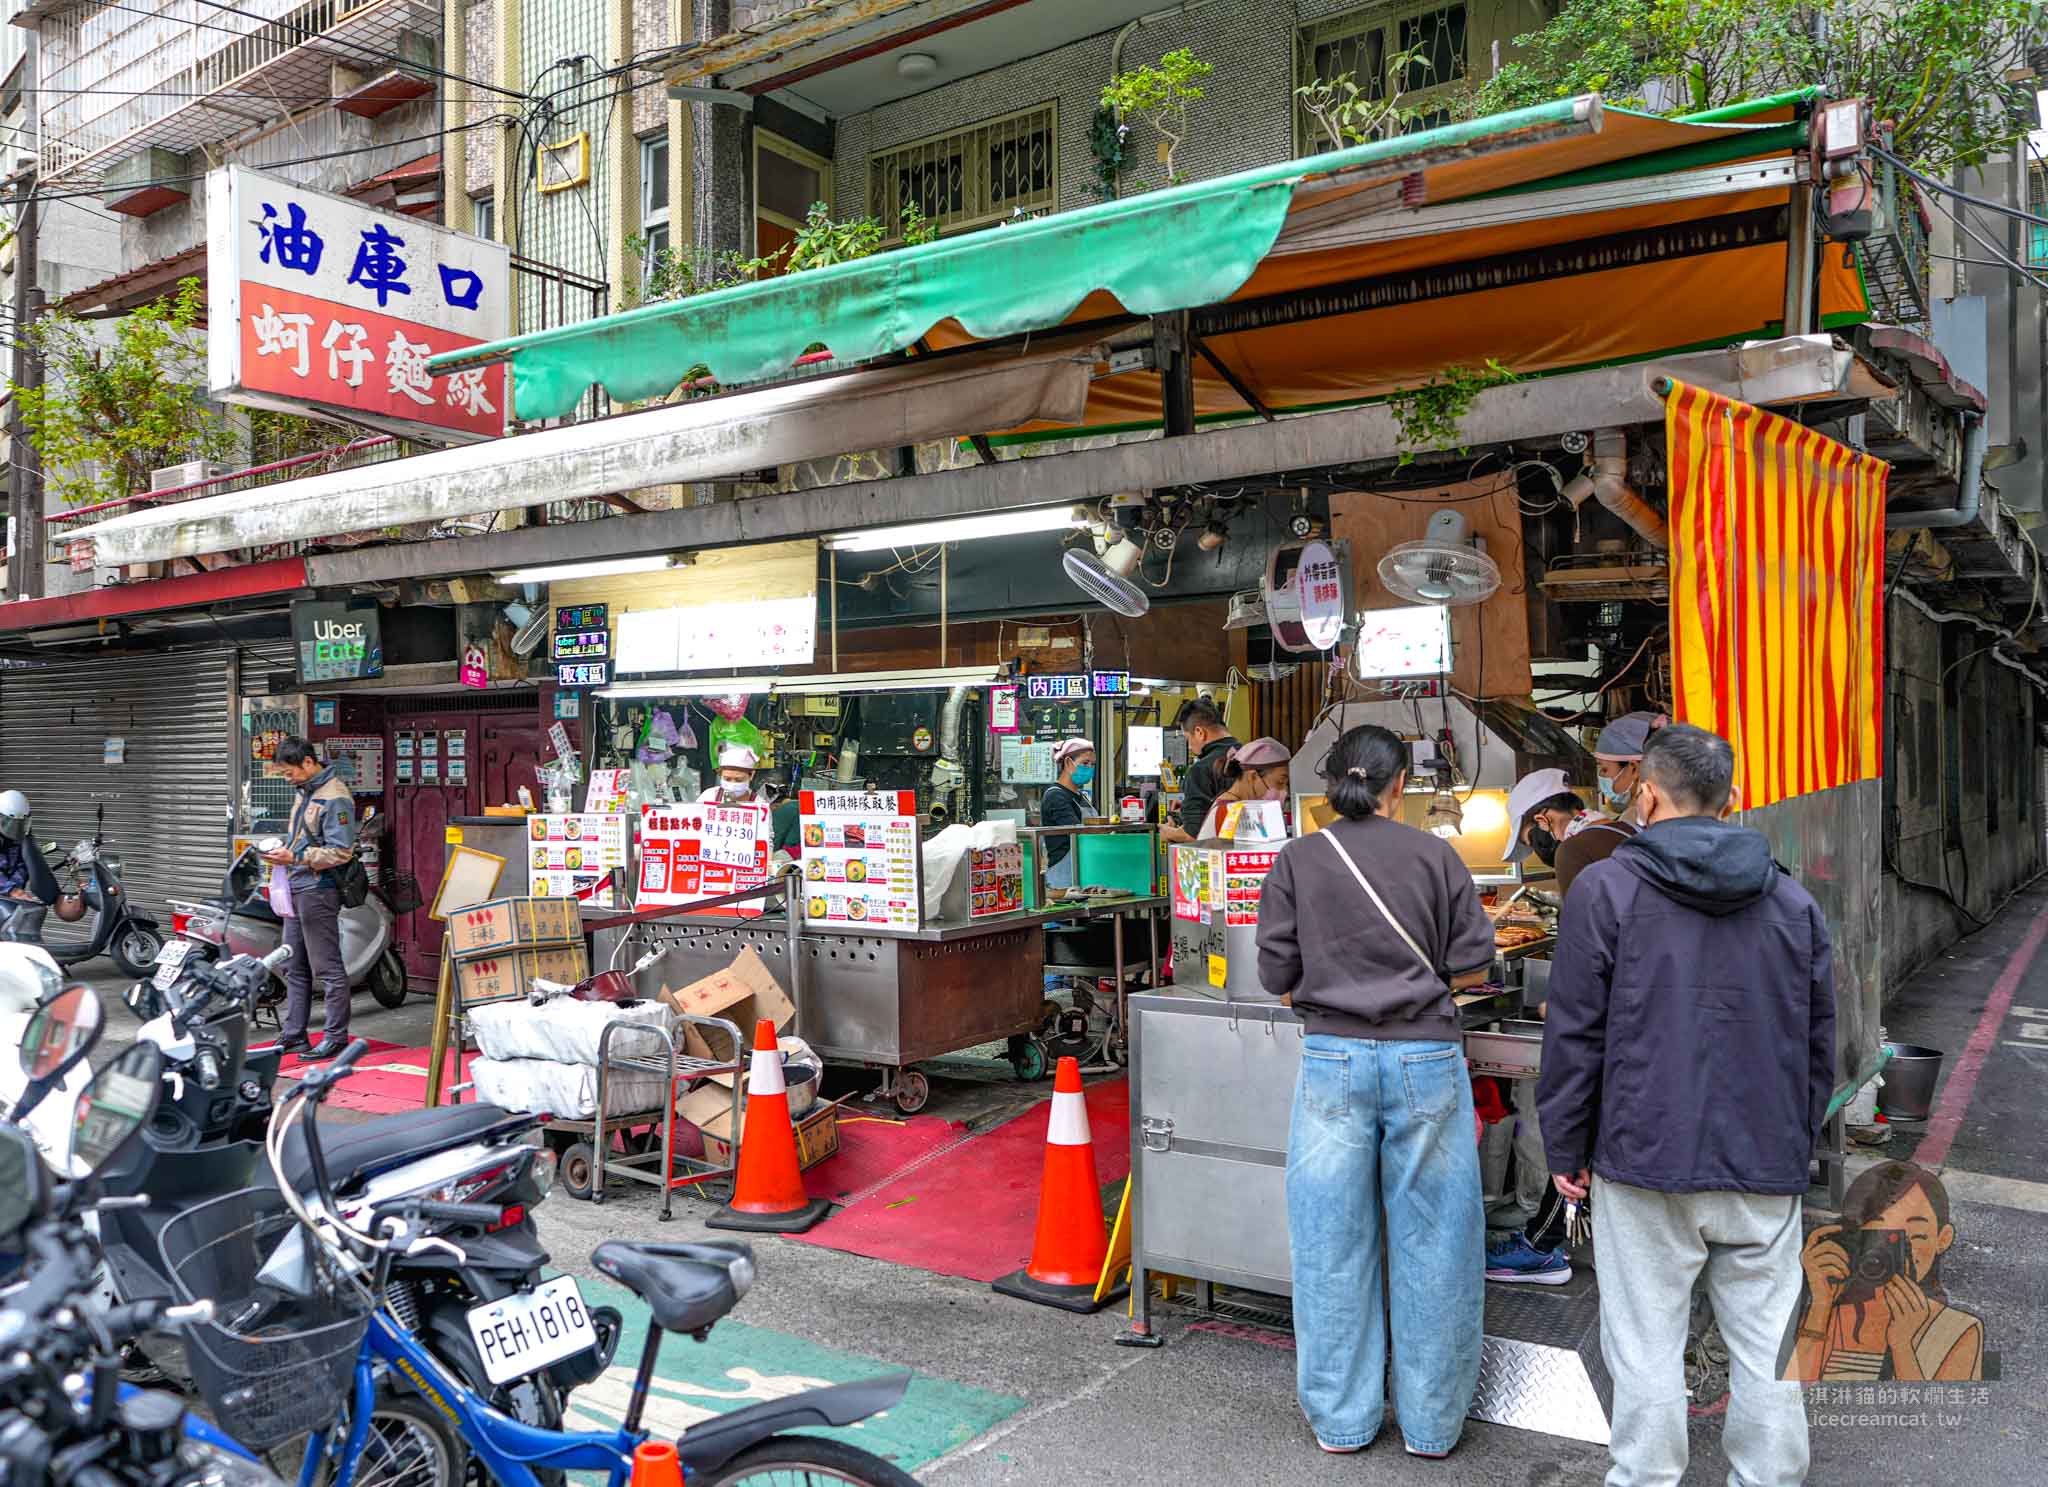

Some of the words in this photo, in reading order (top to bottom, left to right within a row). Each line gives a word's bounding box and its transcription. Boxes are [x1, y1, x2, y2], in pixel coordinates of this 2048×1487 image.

[259, 202, 484, 311] 油庫口
[251, 303, 497, 417] 蚵仔麵線
[313, 619, 363, 640] Uber
[316, 640, 367, 661] Eats
[562, 664, 602, 683] 取餐區
[1032, 678, 1085, 696] 內用區
[707, 808, 753, 826] 營業時間
